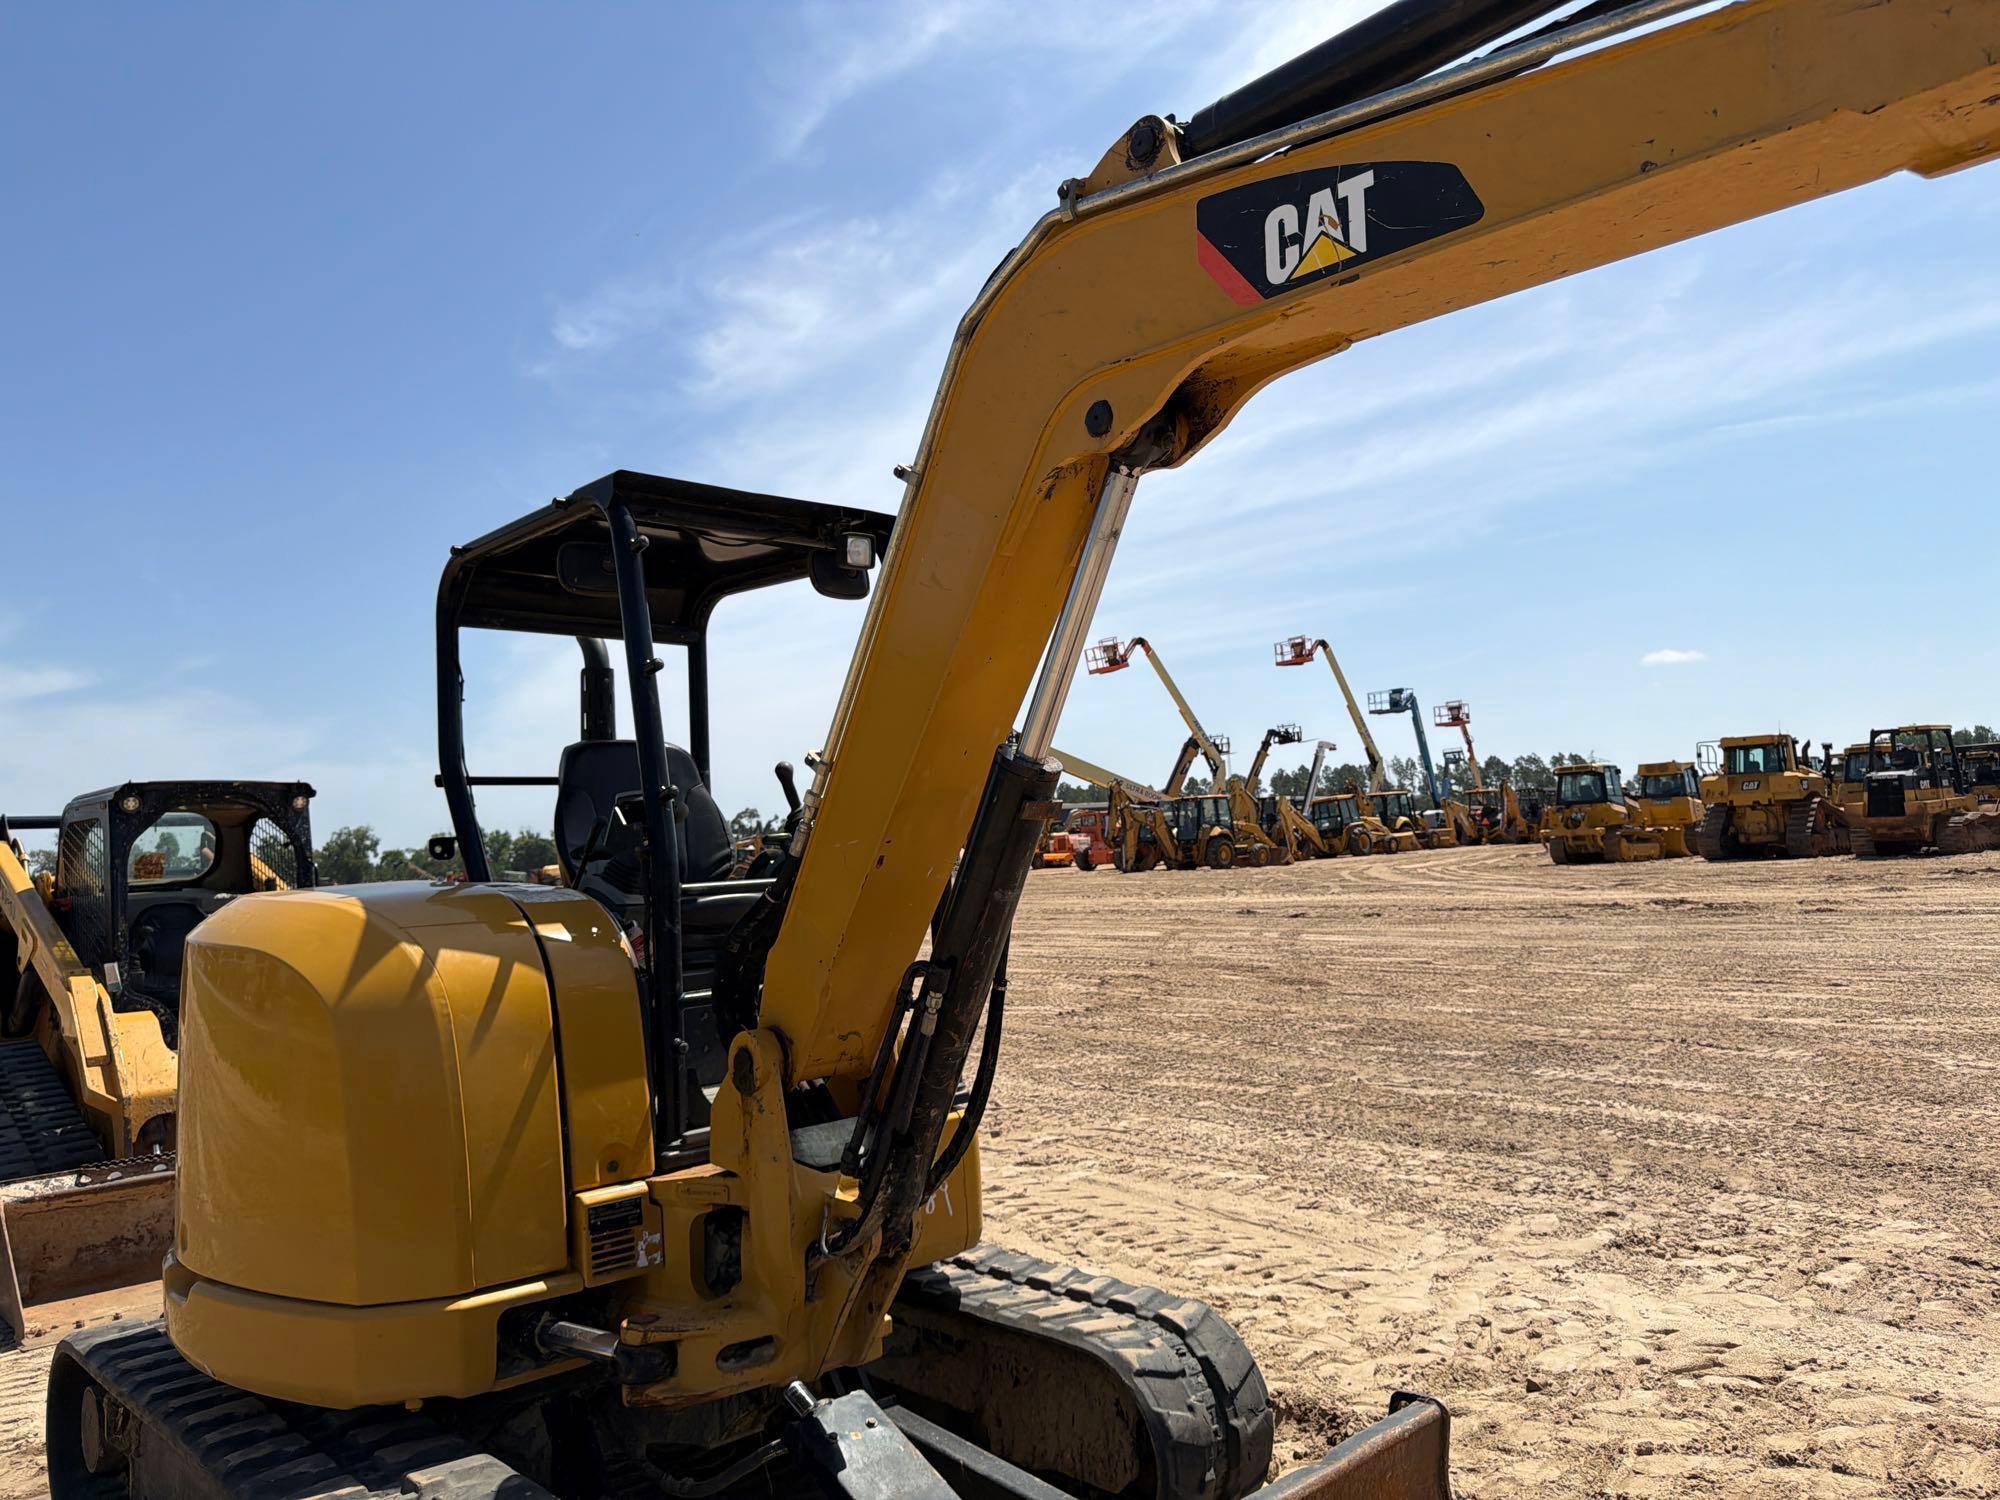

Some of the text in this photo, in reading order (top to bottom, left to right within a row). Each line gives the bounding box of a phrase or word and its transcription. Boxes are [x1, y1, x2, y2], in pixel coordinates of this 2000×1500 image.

[1264, 169, 1375, 285] CAT
[1742, 780, 1760, 791] CAT
[1919, 779, 1931, 790] CAT
